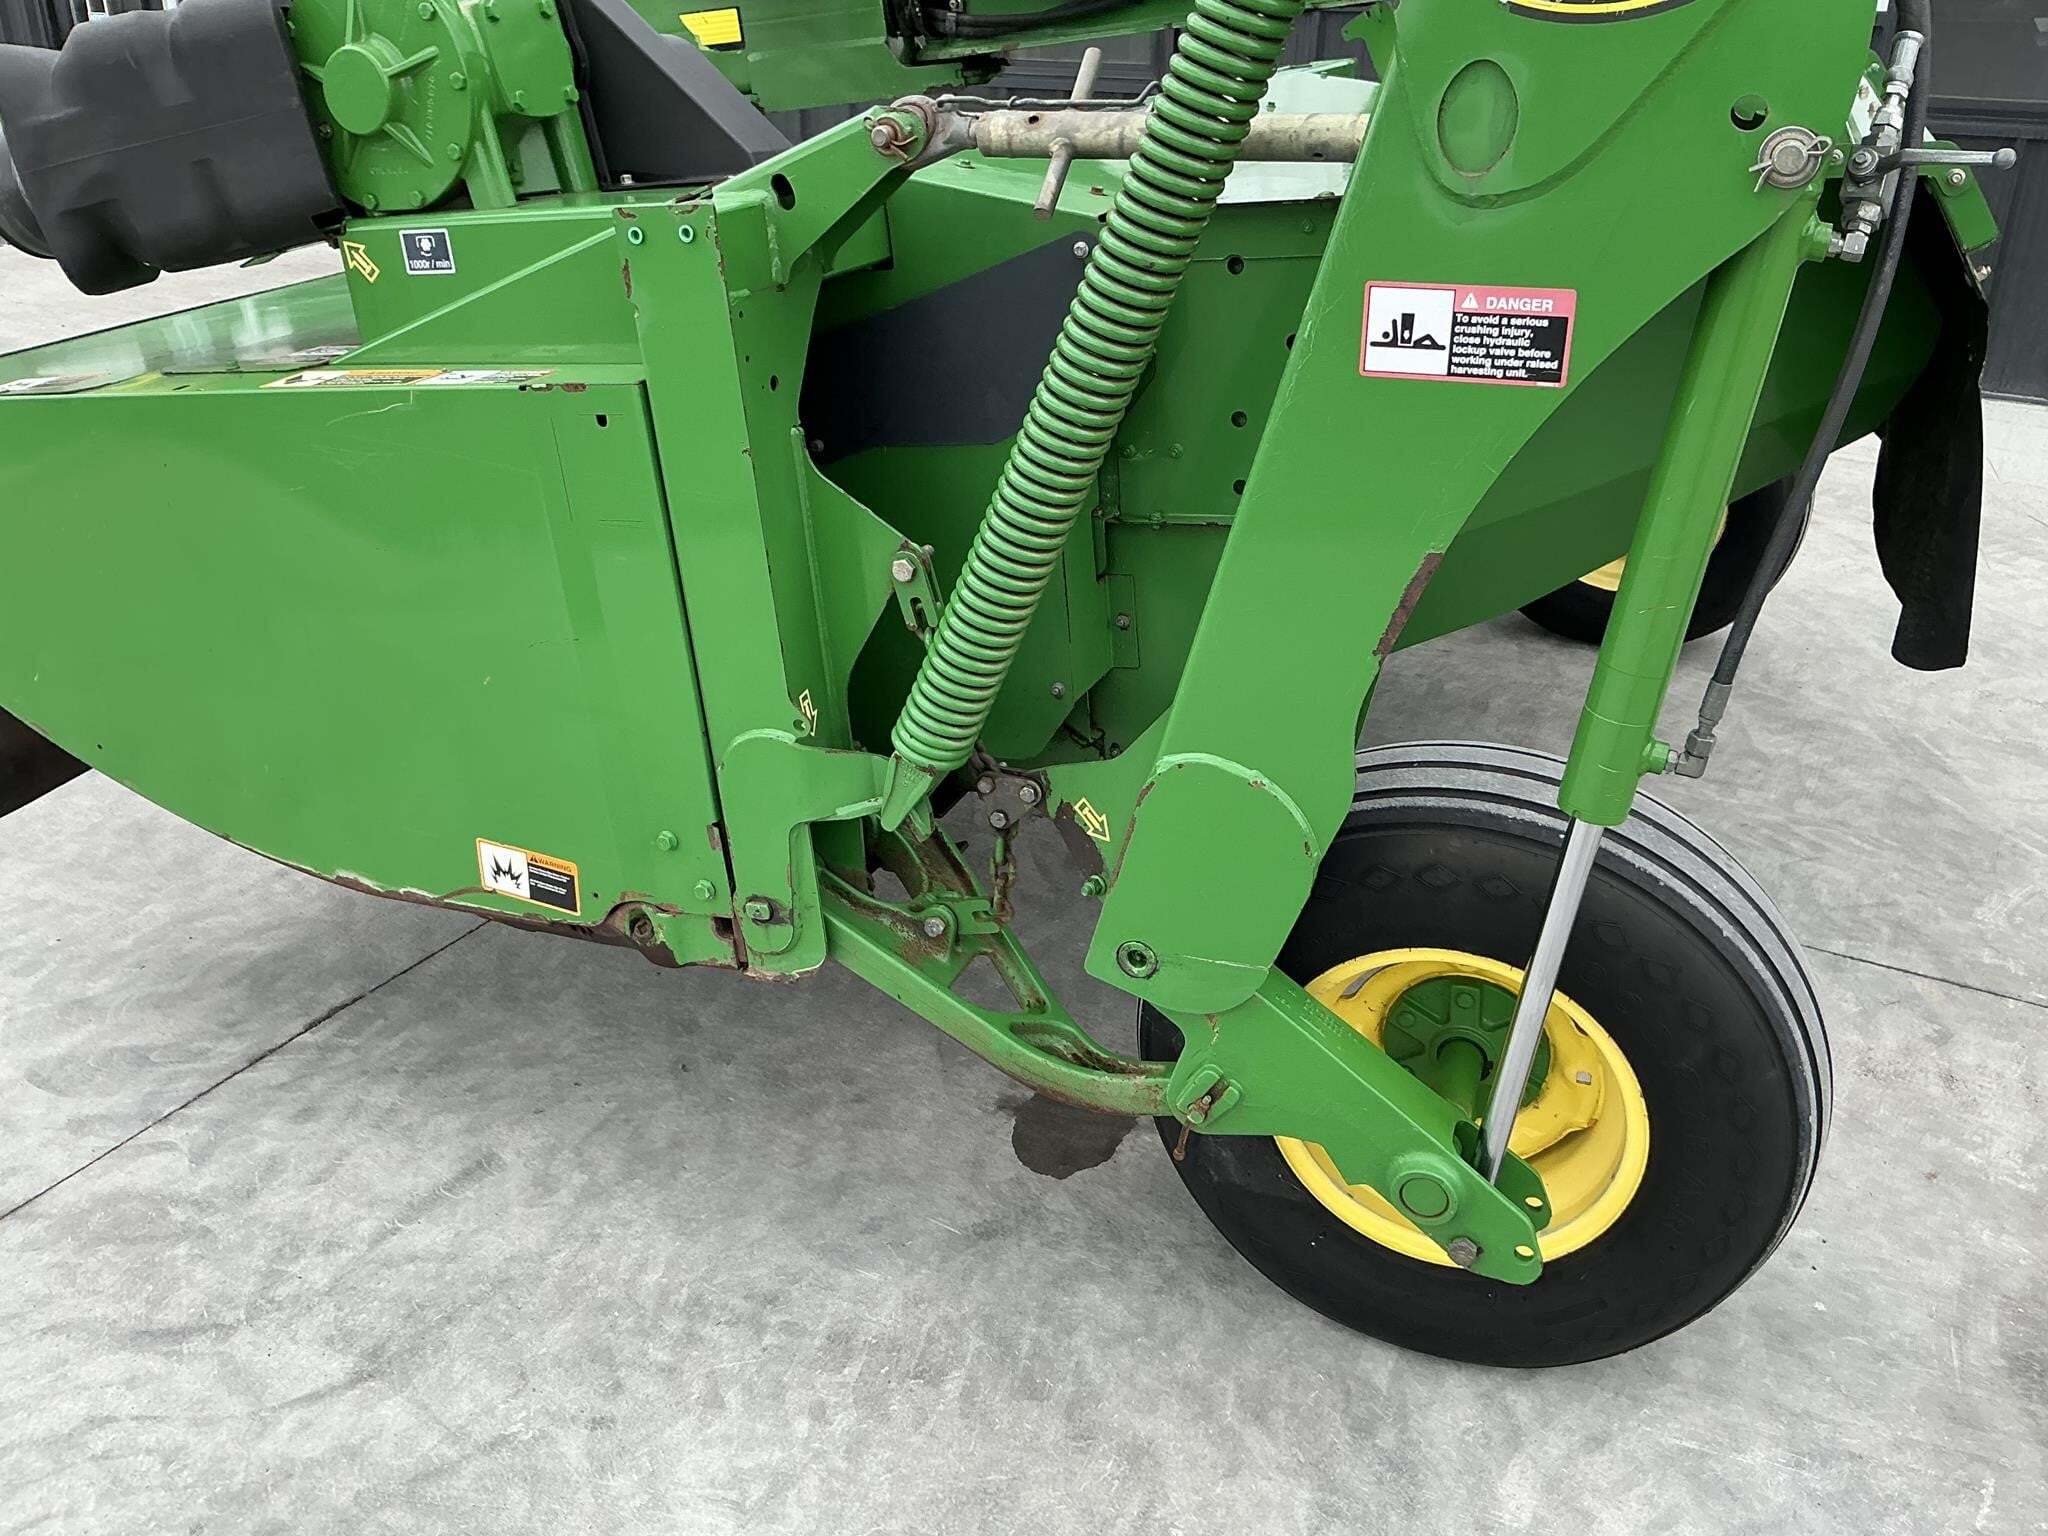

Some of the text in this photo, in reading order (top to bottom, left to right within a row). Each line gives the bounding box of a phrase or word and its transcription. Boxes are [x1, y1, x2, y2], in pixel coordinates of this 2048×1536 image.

[435, 259, 451, 269] min
[1486, 296, 1553, 312] DANGER
[1455, 313, 1549, 327] To avoid a serious
[1454, 325, 1533, 338] crushing injury,
[1453, 335, 1530, 347] close hydraulic
[1452, 345, 1551, 359] lockup valve before
[1451, 355, 1558, 369] working under raised
[1450, 365, 1528, 378] harvesting unit.
[538, 858, 572, 872] WARNING
